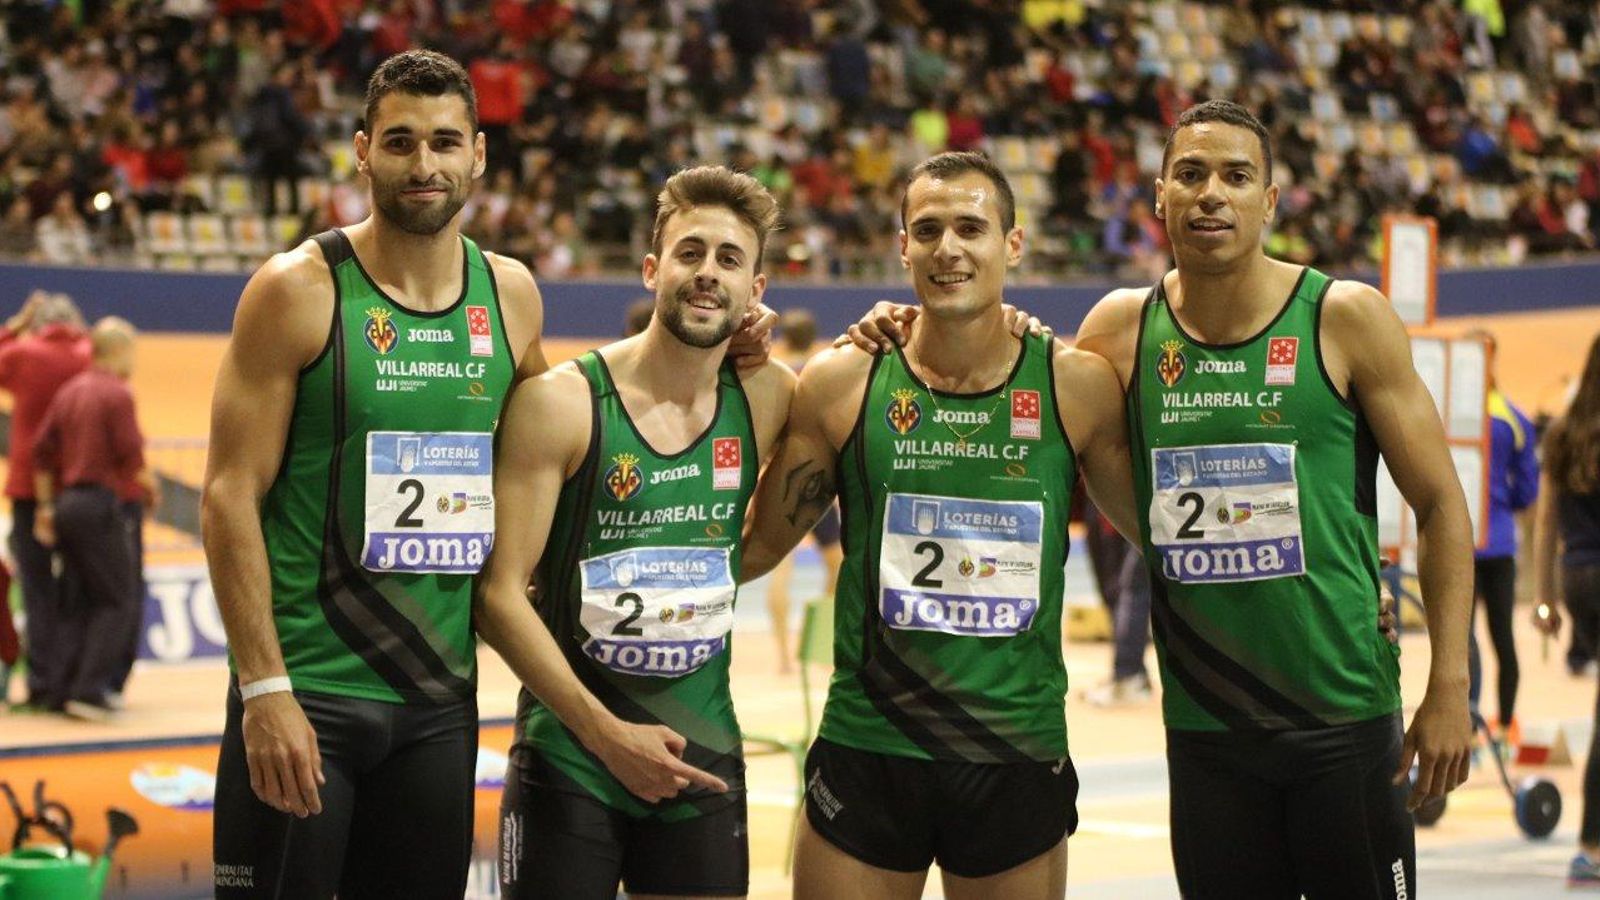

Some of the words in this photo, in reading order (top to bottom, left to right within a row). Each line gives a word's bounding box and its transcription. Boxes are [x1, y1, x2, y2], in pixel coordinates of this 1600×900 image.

[375, 360, 462, 377] VILLARREAL
[376, 379, 397, 391] UJI
[1162, 391, 1253, 408] VILLARREAL
[1161, 411, 1179, 423] UJI
[423, 446, 479, 459] LOTERÍAS
[894, 440, 998, 459] VILLARREAL
[1002, 445, 1029, 460] C.F
[894, 458, 915, 470] UJI
[1201, 455, 1266, 471] LOTERÍAS
[394, 479, 425, 527] 2
[597, 504, 707, 526] VILLARREAL
[944, 512, 1017, 527] LOTERÍAS
[1175, 492, 1205, 539] 2
[600, 529, 624, 539] UJI
[378, 538, 484, 569] Joma
[642, 559, 706, 574] LOTERÍAS
[911, 541, 944, 588] 2
[612, 592, 644, 636] 2
[895, 594, 1020, 629] Joma
[595, 644, 711, 671] Joma
